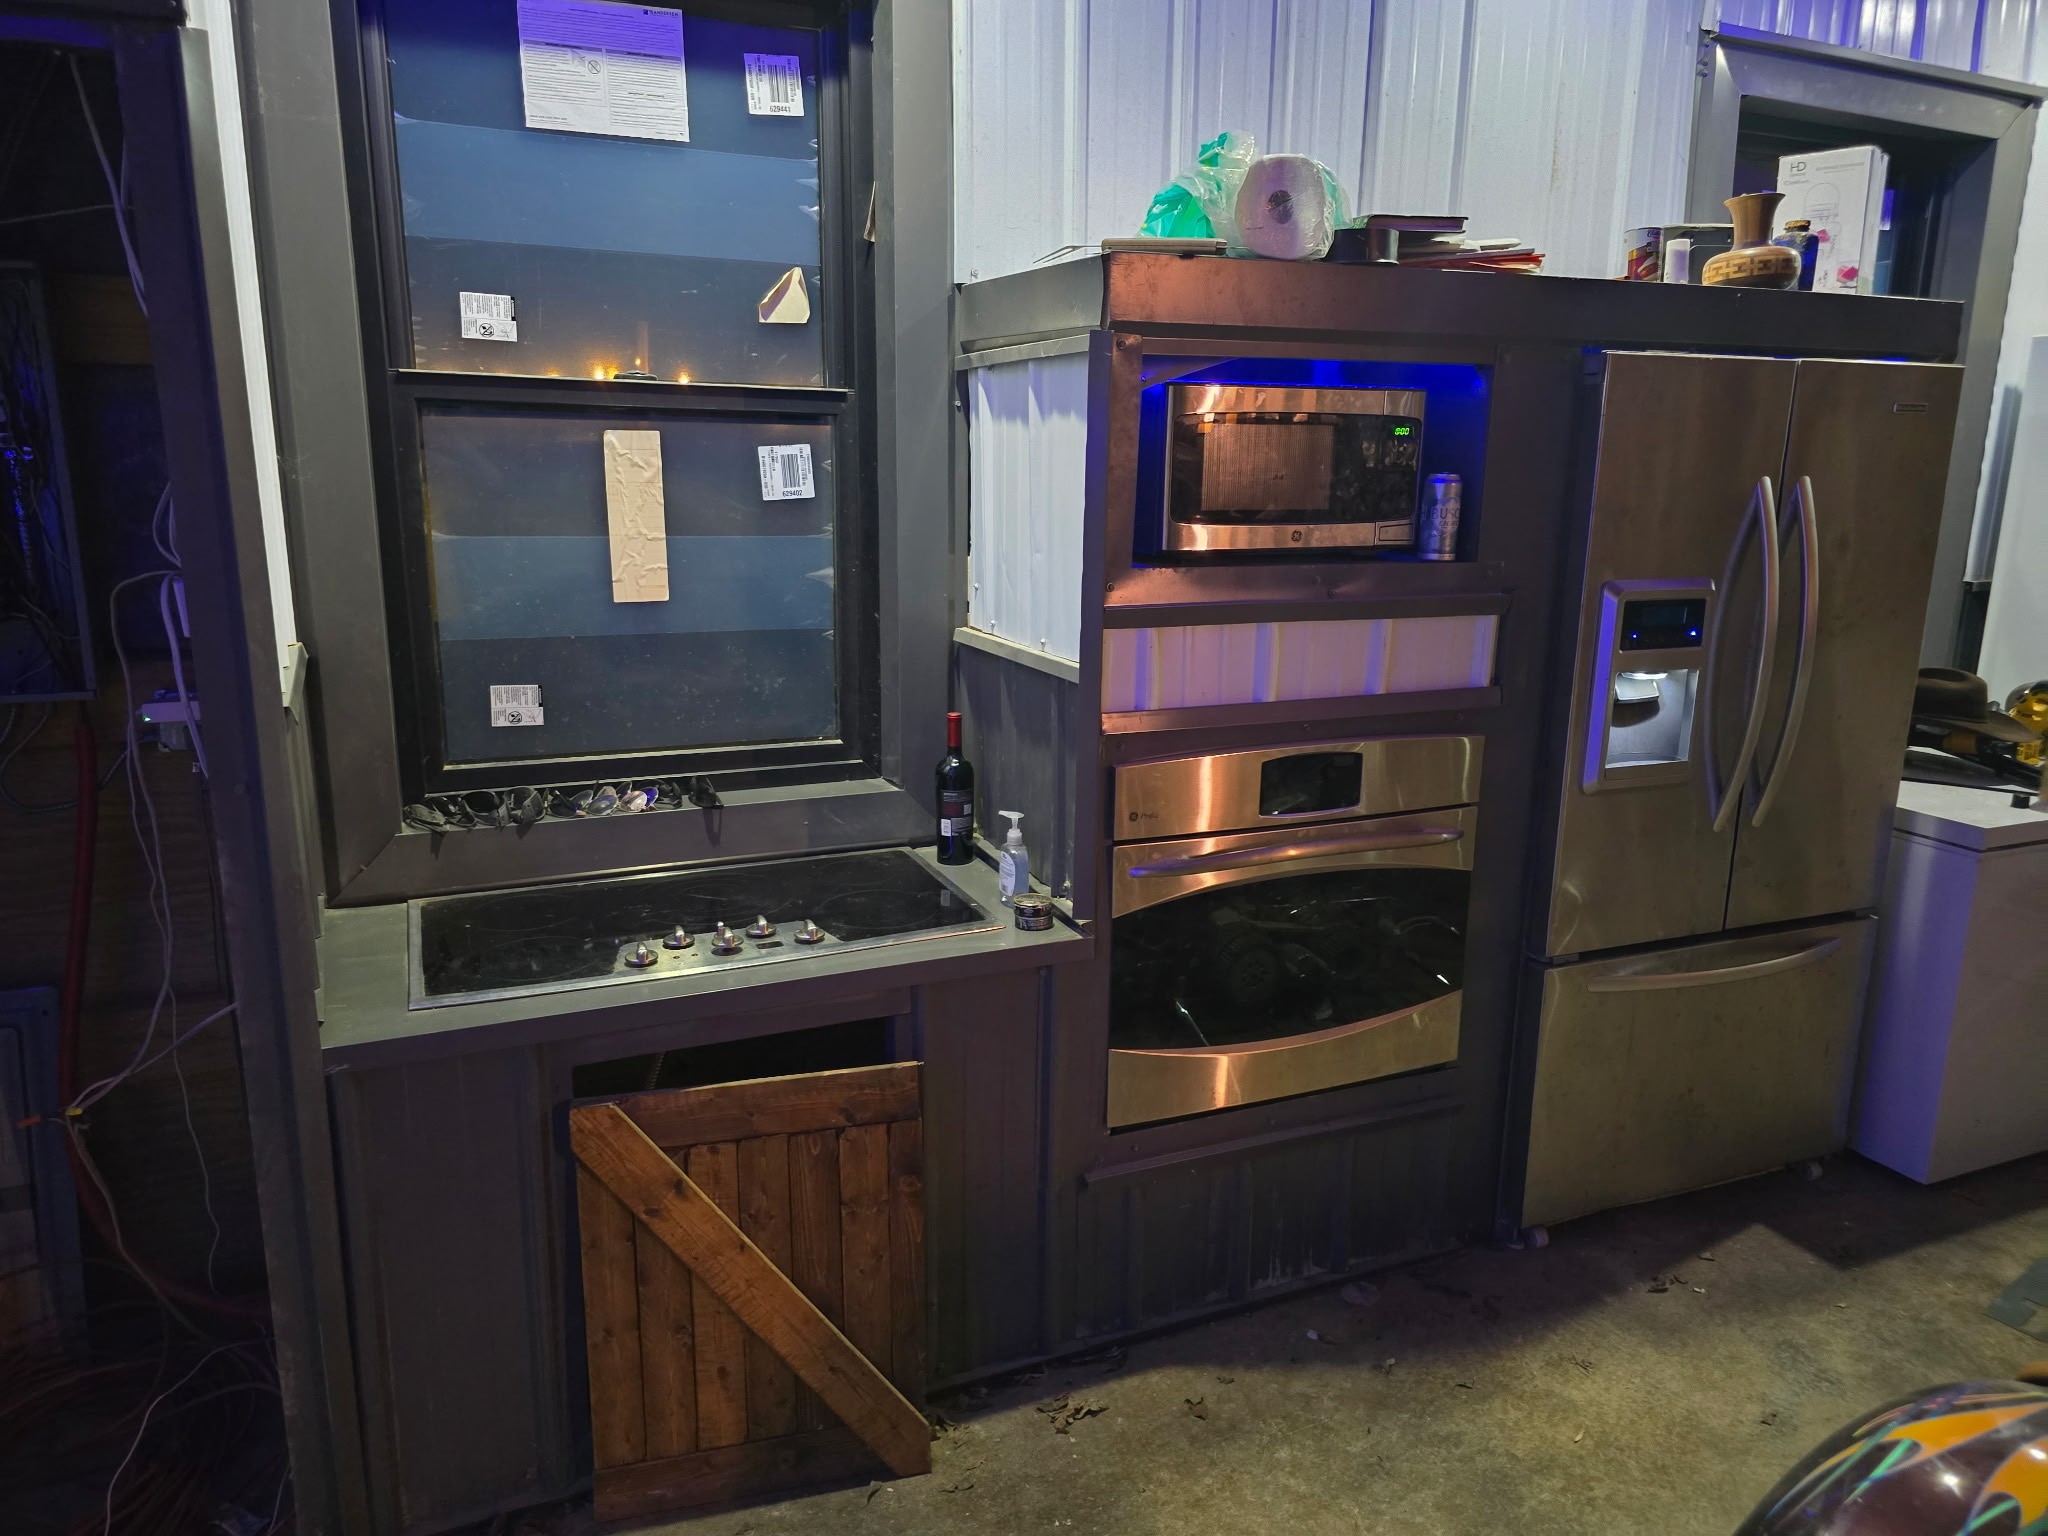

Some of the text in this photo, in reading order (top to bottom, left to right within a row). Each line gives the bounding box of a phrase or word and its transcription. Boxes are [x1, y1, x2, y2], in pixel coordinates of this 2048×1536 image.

[769, 105, 791, 113] 629441
[1790, 161, 1807, 173] HD
[782, 489, 803, 498] 629402
